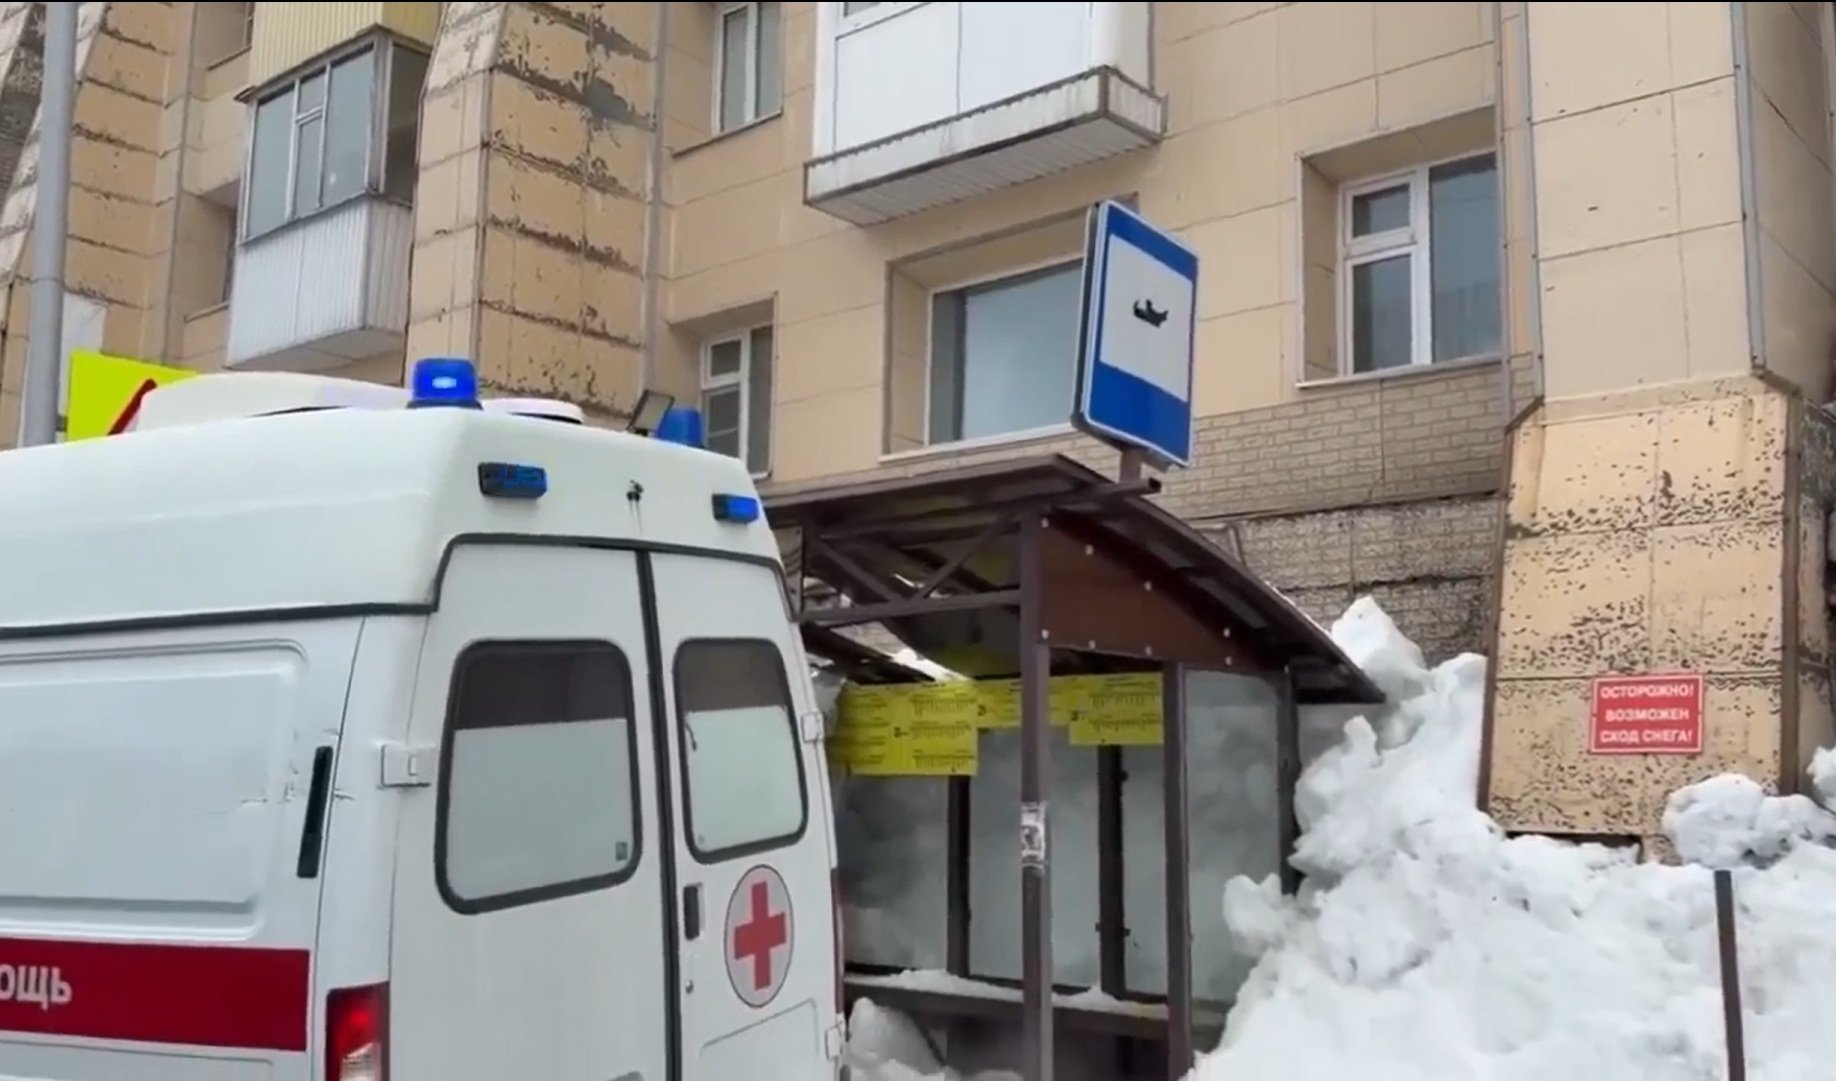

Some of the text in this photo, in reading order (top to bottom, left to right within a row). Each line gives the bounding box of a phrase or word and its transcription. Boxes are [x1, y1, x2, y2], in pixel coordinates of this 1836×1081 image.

[1600, 683, 1695, 699] ОСТОРОЖНО!
[1604, 708, 1691, 722] ВОЗМОЖЕН
[1600, 729, 1694, 744] СХОД СНЕГА!
